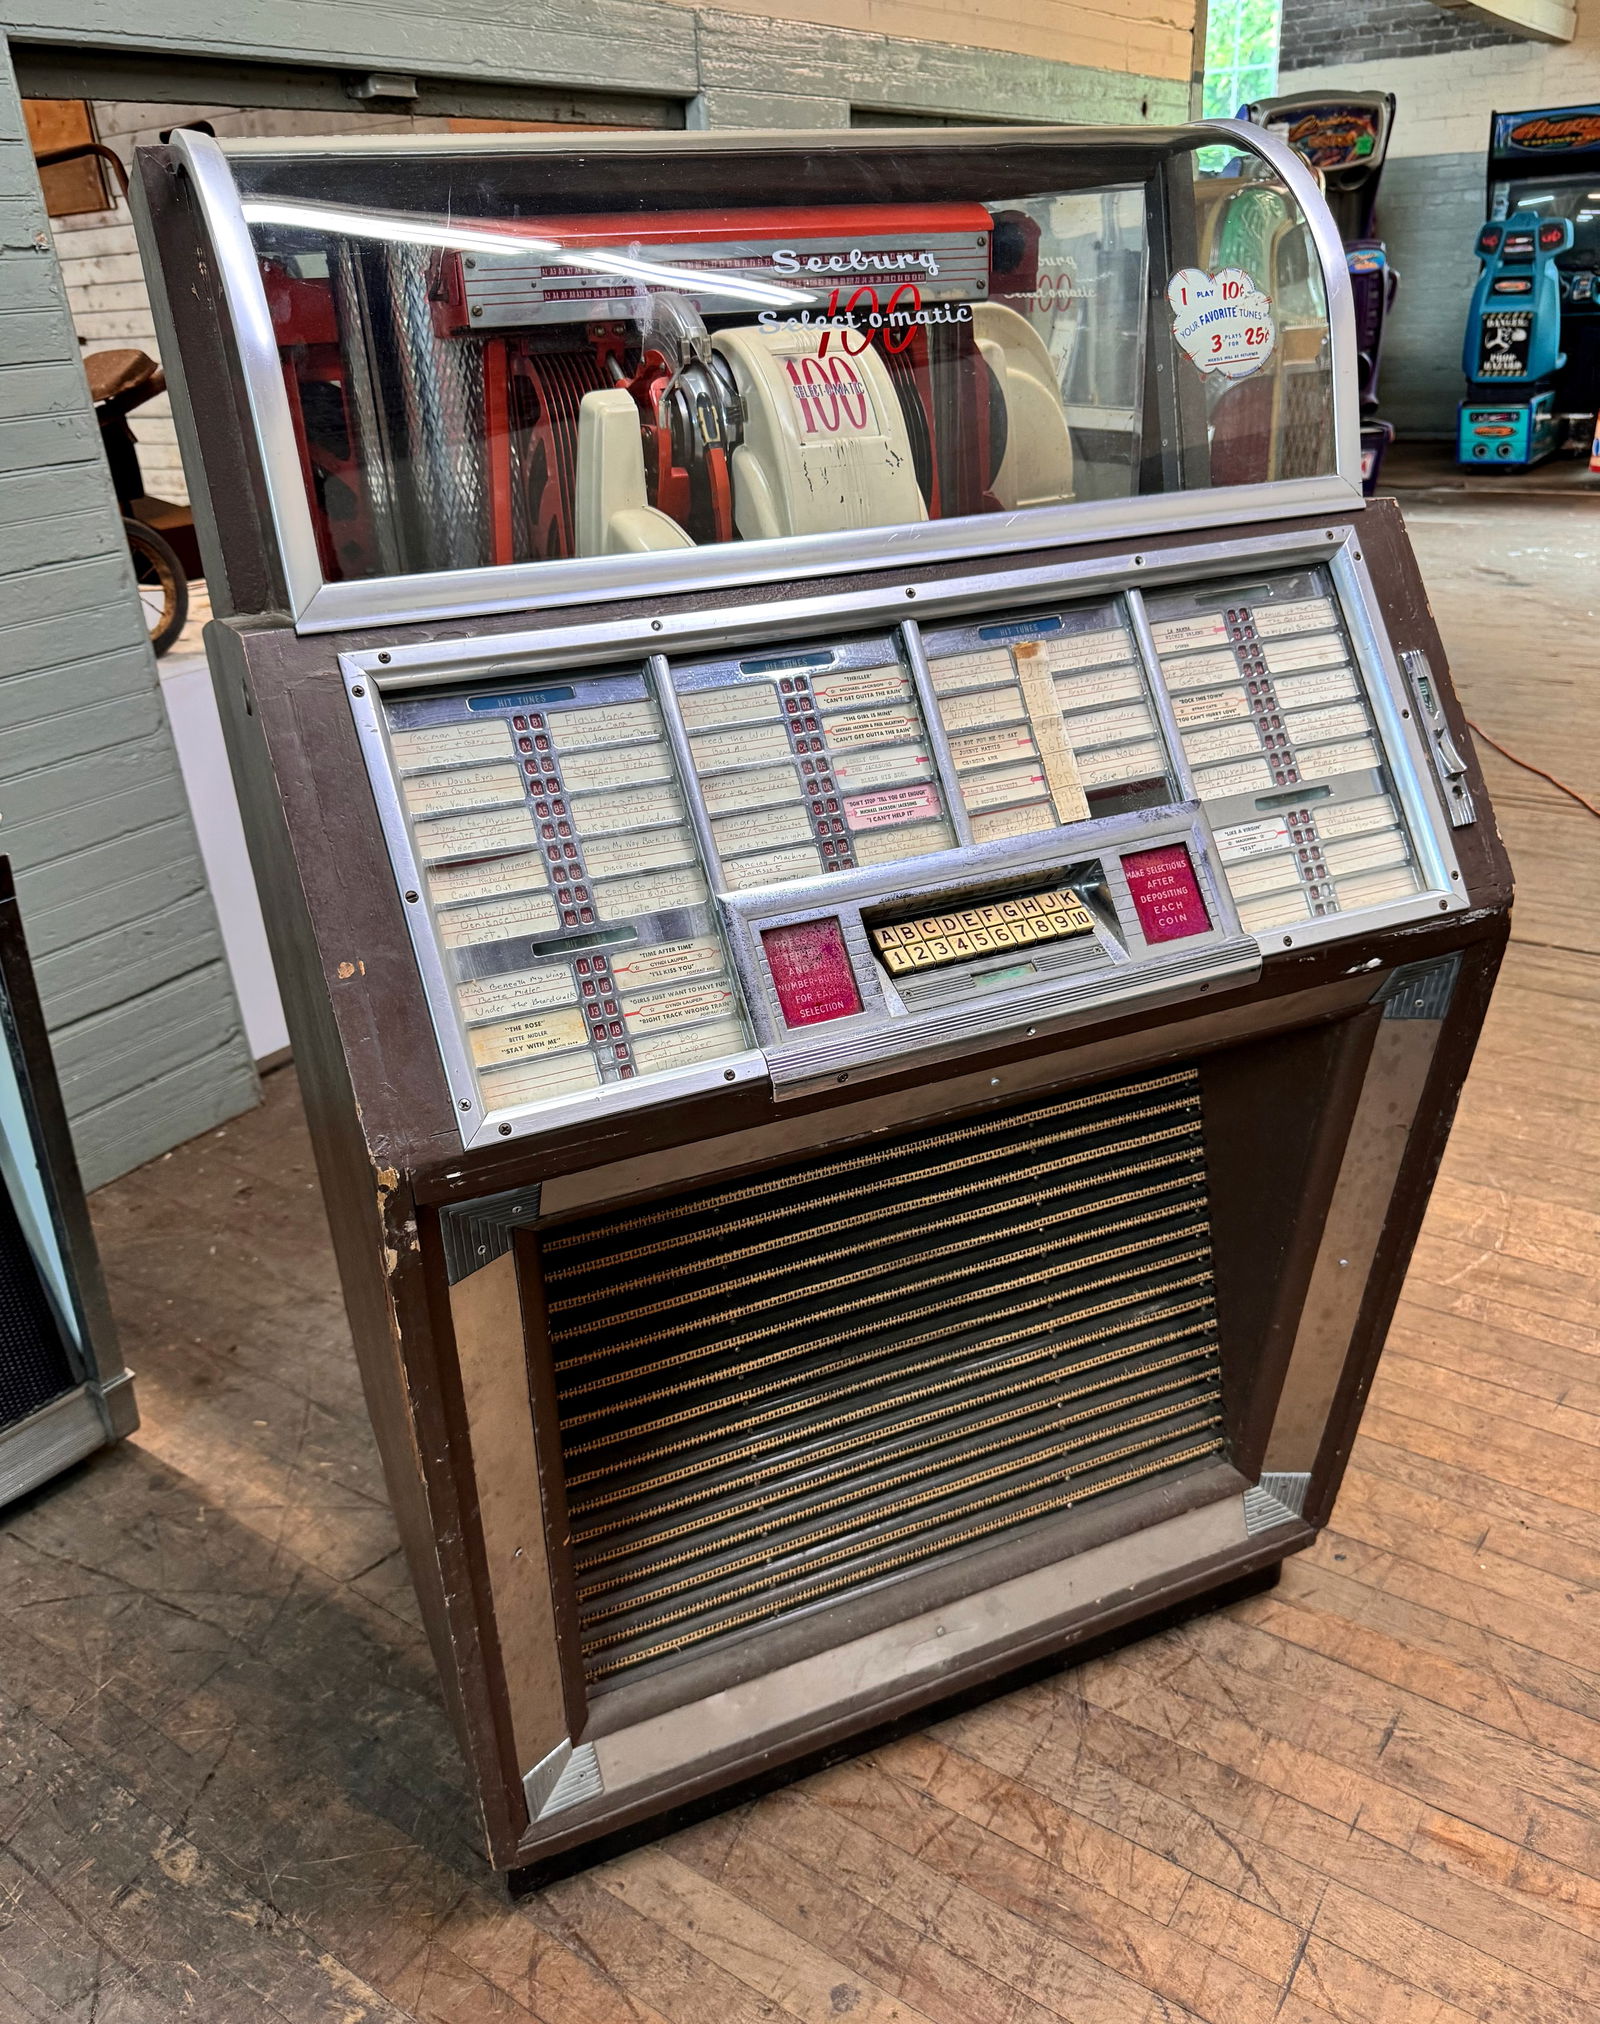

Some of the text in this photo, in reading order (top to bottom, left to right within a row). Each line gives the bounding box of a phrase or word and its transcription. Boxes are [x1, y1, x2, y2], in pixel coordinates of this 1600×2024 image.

[771, 249, 940, 275] Seeburg
[1181, 288, 1187, 305] 1
[1196, 290, 1214, 298] PLAY
[818, 284, 921, 359] 100
[1180, 307, 1262, 339] YOUR FAVORITE TUNES
[1211, 334, 1222, 353] 3
[786, 356, 867, 433] 100
[793, 382, 865, 399] SELECT-O-MATIC
[1015, 623, 1038, 634] TUNES
[498, 694, 546, 707] HIT TUNES
[517, 717, 542, 729] A1 B1
[866, 731, 884, 739] OUTTA
[522, 739, 548, 751] A2 B2
[527, 761, 553, 773] A3 B3
[533, 782, 559, 793] A4 B4
[538, 804, 564, 817] A5 B5
[1126, 860, 1187, 879] MAKE SELECTIONS
[1147, 876, 1175, 889] AFTER
[1140, 886, 1189, 903] DEPOSITING
[1153, 901, 1184, 914] EACH
[880, 892, 1077, 944] A B C D E F G H J K
[1158, 913, 1187, 926] COIN
[893, 911, 1090, 965] 1 2 3 4 5 6 7 8 9 10
[667, 990, 687, 998] WANT
[697, 983, 714, 991] HAVE
[795, 993, 813, 1004] FOR
[662, 1012, 682, 1020] TRACK
[684, 1005, 709, 1015] WRONG
[799, 1000, 844, 1018] SELECTION
[508, 1035, 525, 1043] BETTE
[527, 1041, 545, 1050] WITH
